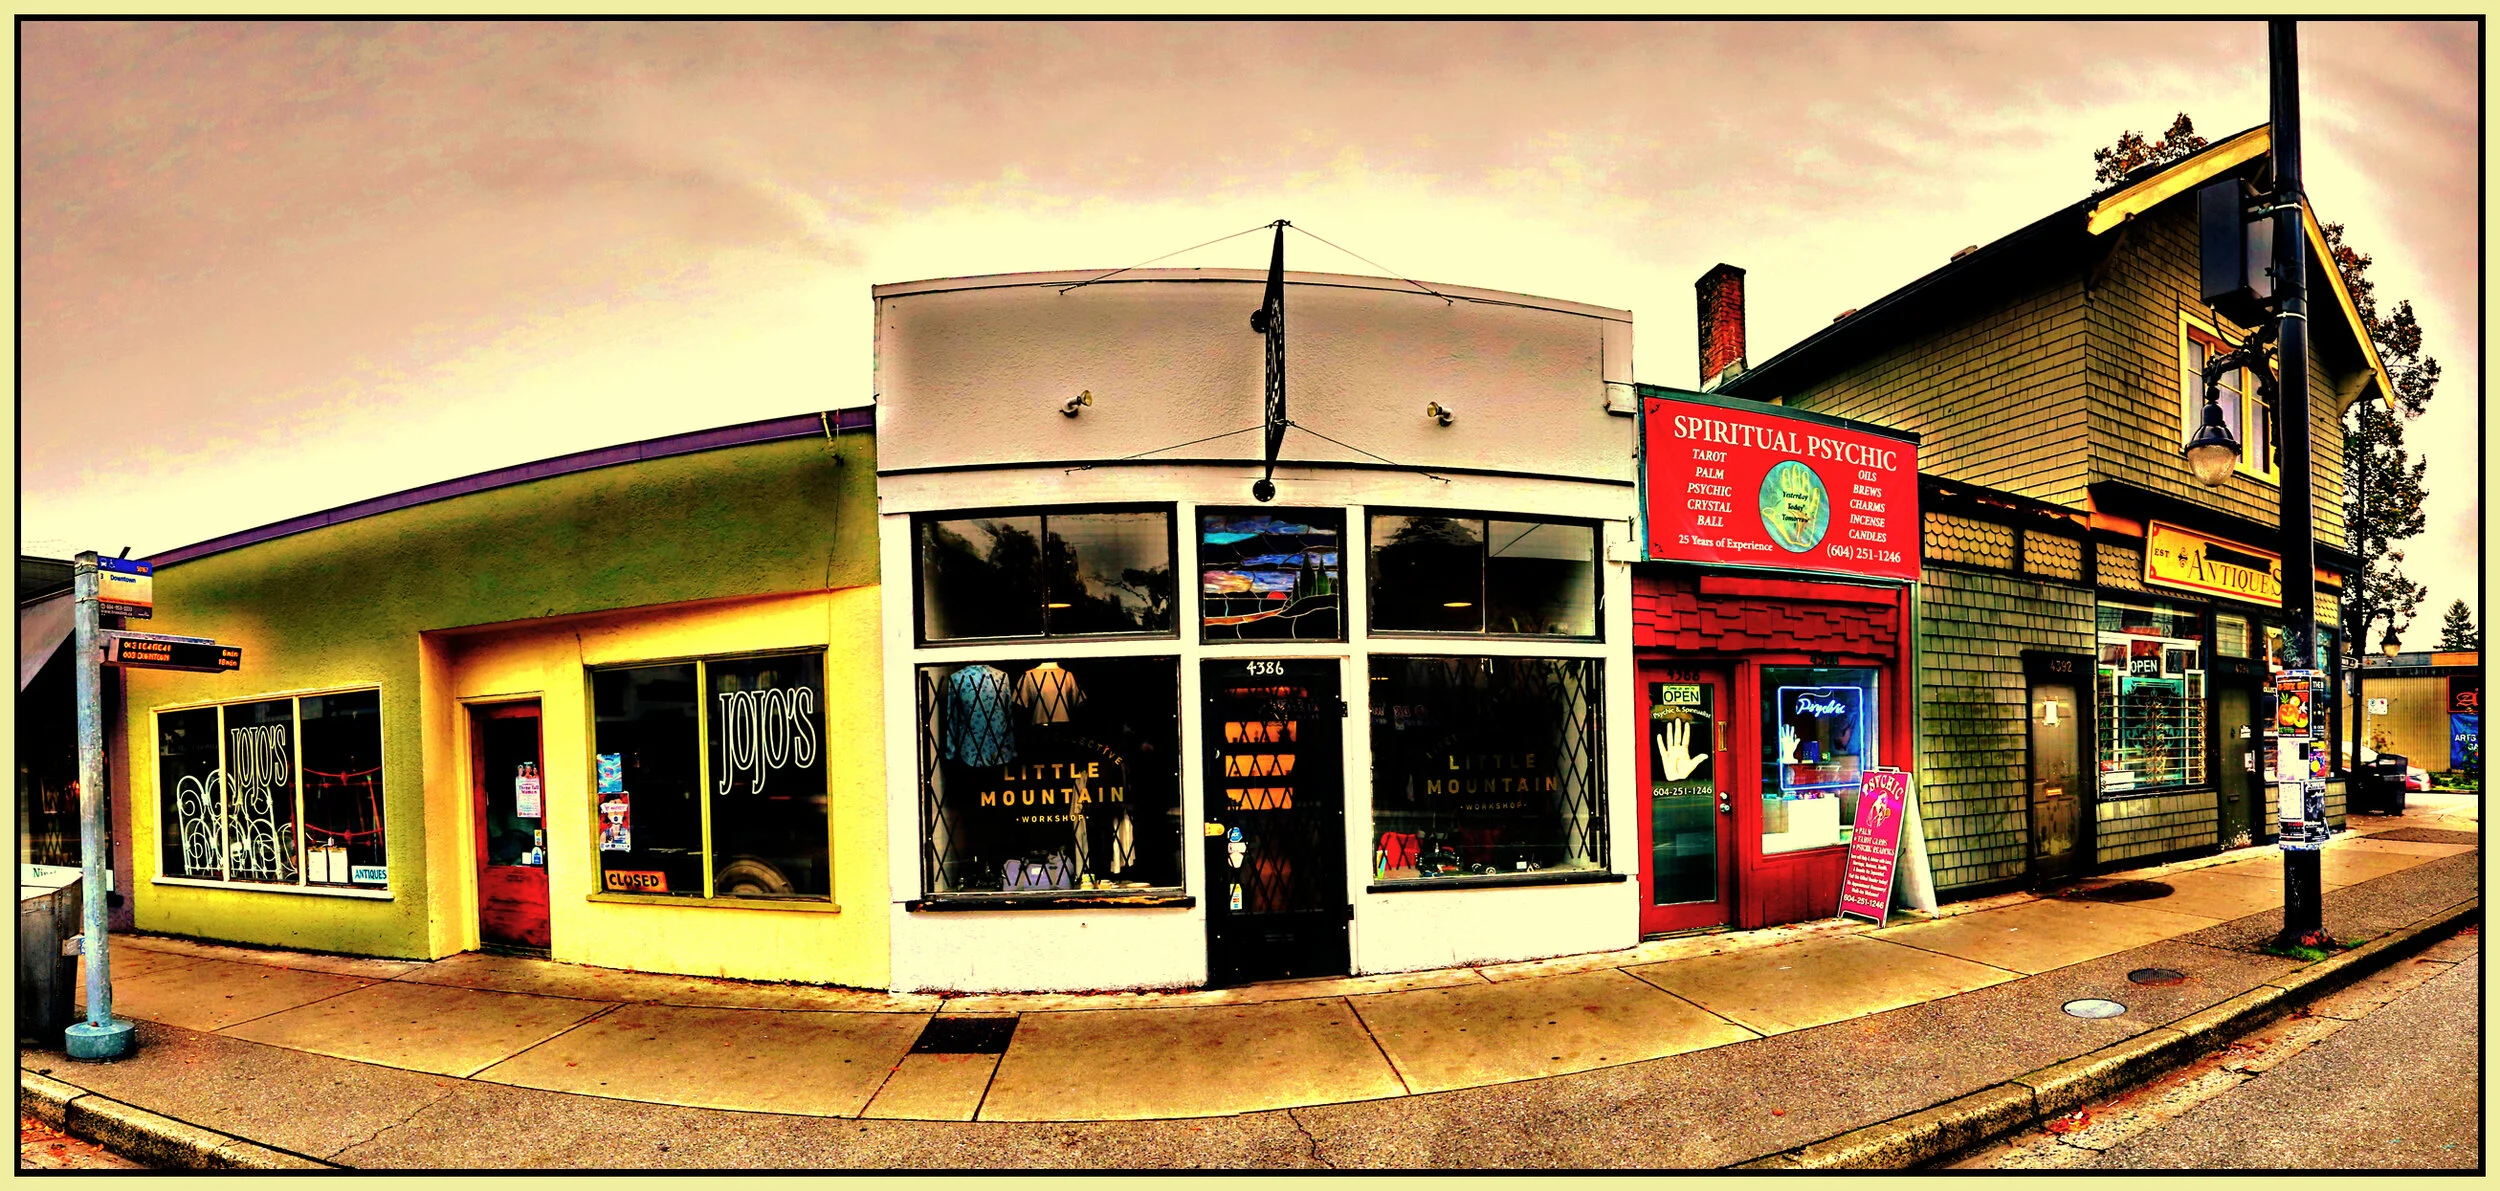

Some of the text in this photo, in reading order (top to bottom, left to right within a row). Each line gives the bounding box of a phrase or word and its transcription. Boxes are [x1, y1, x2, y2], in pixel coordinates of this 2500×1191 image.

[1674, 414, 1898, 472] SPIRITUAL PSYCHIC
[1692, 448, 1727, 463] TAROT
[1695, 466, 1724, 480] PALM
[1858, 470, 1877, 482] OILS
[1687, 482, 1732, 498] PSYCHIC
[1783, 491, 1808, 501] Yesterday
[1853, 484, 1882, 498] BREWS
[1687, 498, 1732, 513] CRYSTAL
[1849, 499, 1885, 513] CHARMS
[1697, 515, 1724, 528] BALL
[1849, 514, 1885, 528] INCENSE
[1678, 534, 1773, 552] 25 Years of Experience
[1849, 529, 1887, 543] CANDLES
[1826, 543, 1901, 563] (604) 251-1246
[2154, 548, 2170, 558] EST
[110, 574, 136, 583] Downtown
[2188, 549, 2282, 596] ANTIQUES
[1246, 661, 1284, 676] 4386
[2050, 660, 2072, 672] 4392
[2131, 660, 2158, 673] OPEN
[1664, 690, 1699, 702] OPEN
[1652, 708, 1675, 719] Psychic
[1796, 698, 1846, 718] Psychic
[719, 686, 816, 795] JOJO'S
[231, 724, 288, 806] JOJO'S
[1450, 753, 1536, 770] LITTLE
[1004, 762, 1100, 781] LITTLE
[1427, 776, 1558, 794] MOUNTAIN
[1653, 786, 1712, 796] 604-251-1246
[1862, 774, 1904, 800] PSYCHIC
[981, 786, 1124, 806] MOUNTAIN
[354, 869, 387, 880] ANTIQUES
[609, 874, 659, 887] CLOSED
[1844, 894, 1884, 909] 604-251-1246
